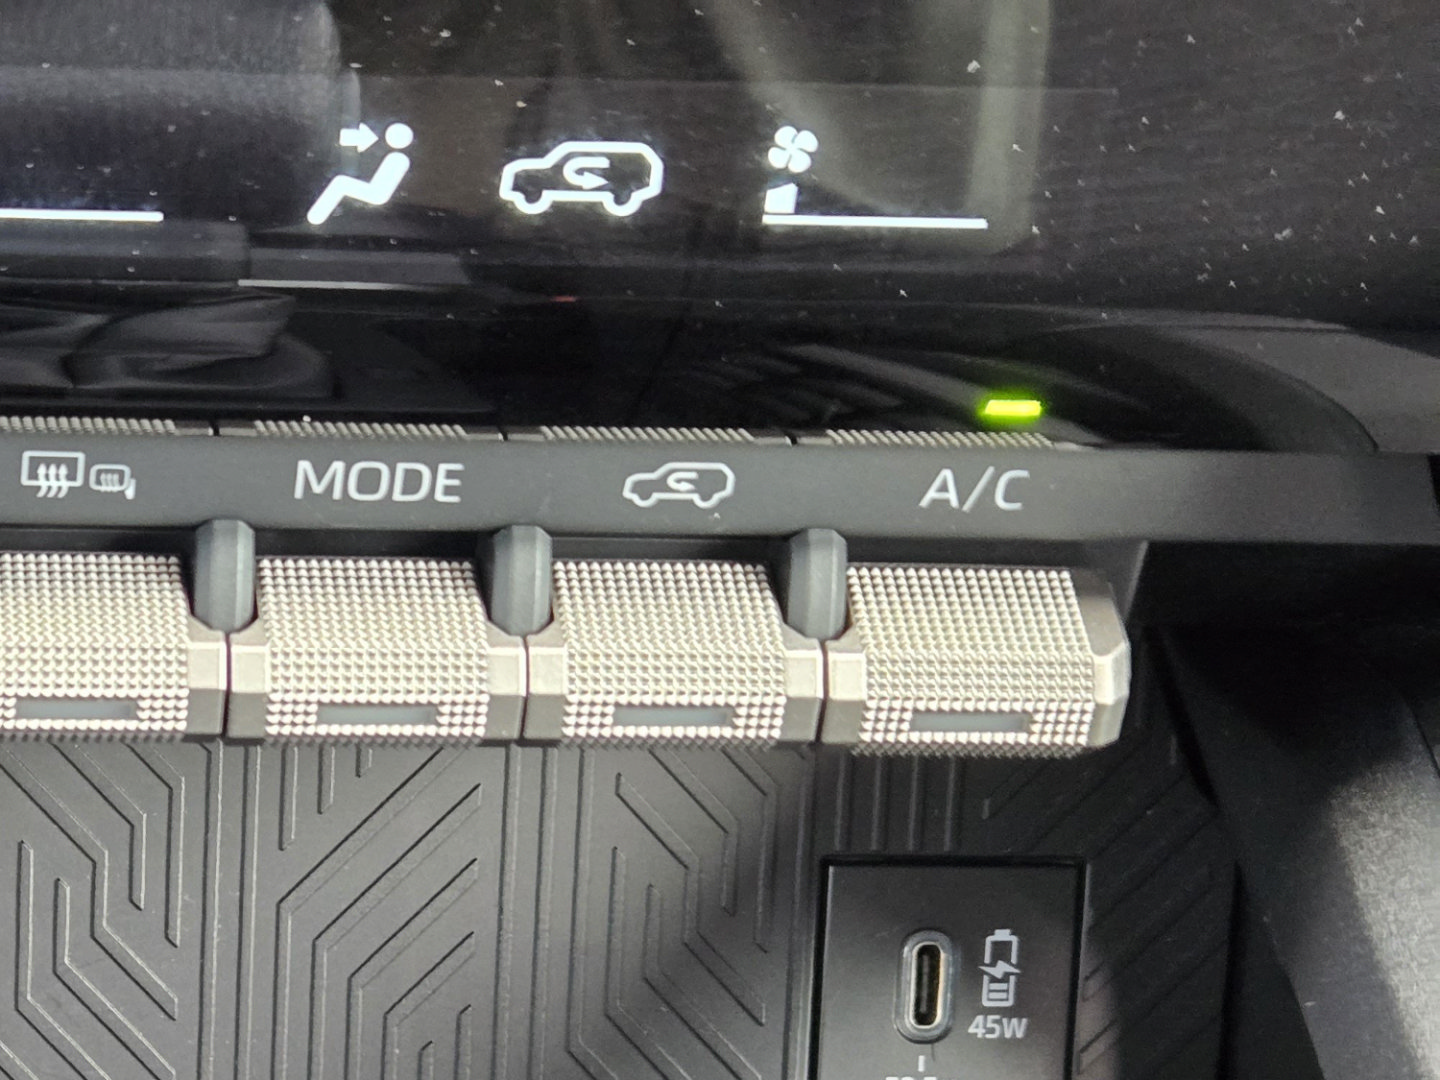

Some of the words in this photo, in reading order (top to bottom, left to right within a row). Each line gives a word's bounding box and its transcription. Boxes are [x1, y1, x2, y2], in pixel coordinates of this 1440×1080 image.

[294, 460, 464, 504] MODE
[919, 466, 1031, 513] A/C
[967, 1014, 1029, 1040] 45W
